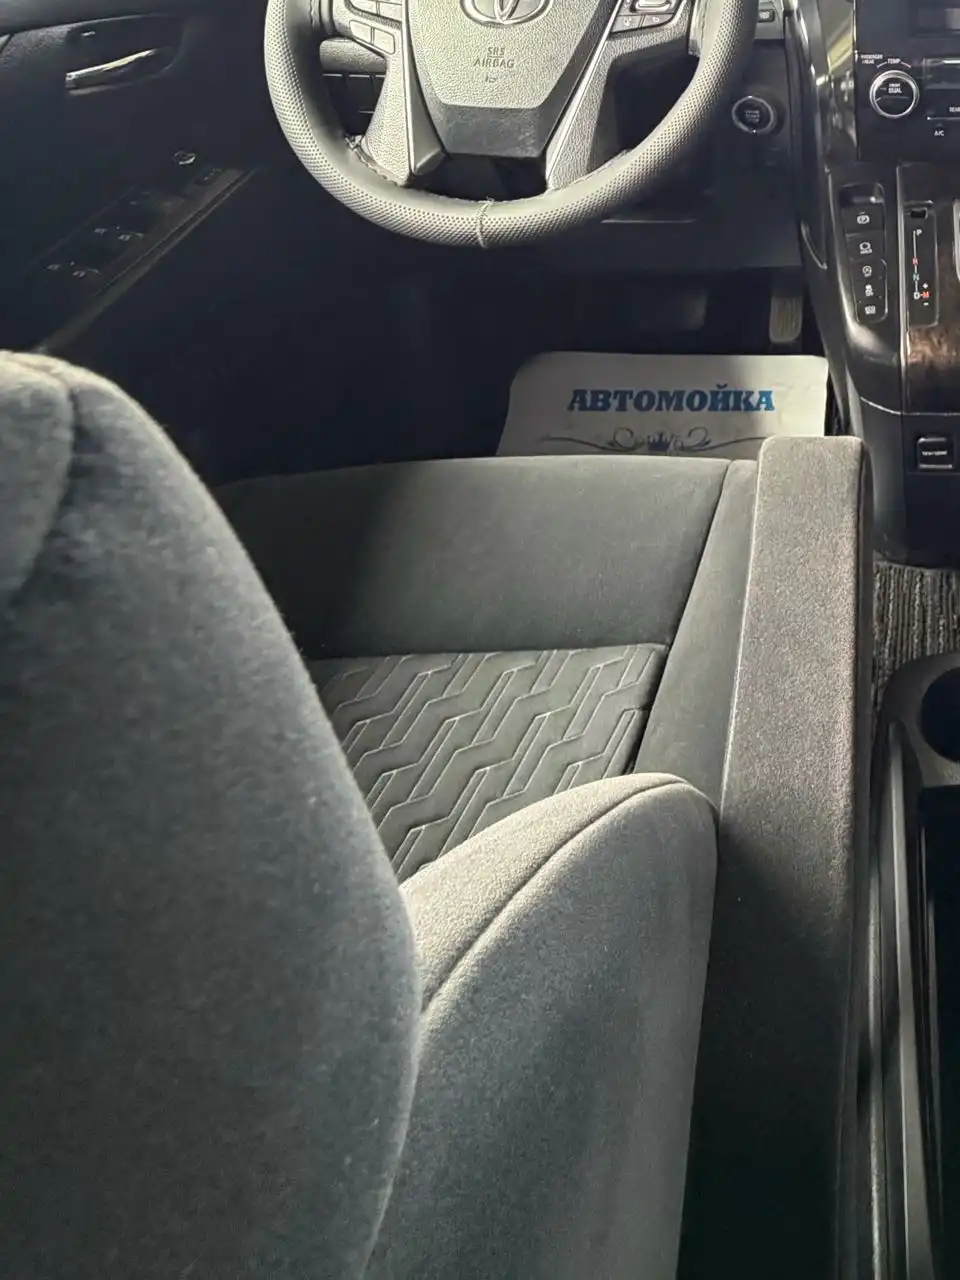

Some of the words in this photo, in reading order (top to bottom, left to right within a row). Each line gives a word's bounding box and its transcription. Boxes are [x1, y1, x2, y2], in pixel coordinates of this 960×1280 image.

[487, 46, 505, 56] SRS
[473, 58, 515, 68] AIRBAG
[567, 383, 776, 412] АВТОМОЙКА
